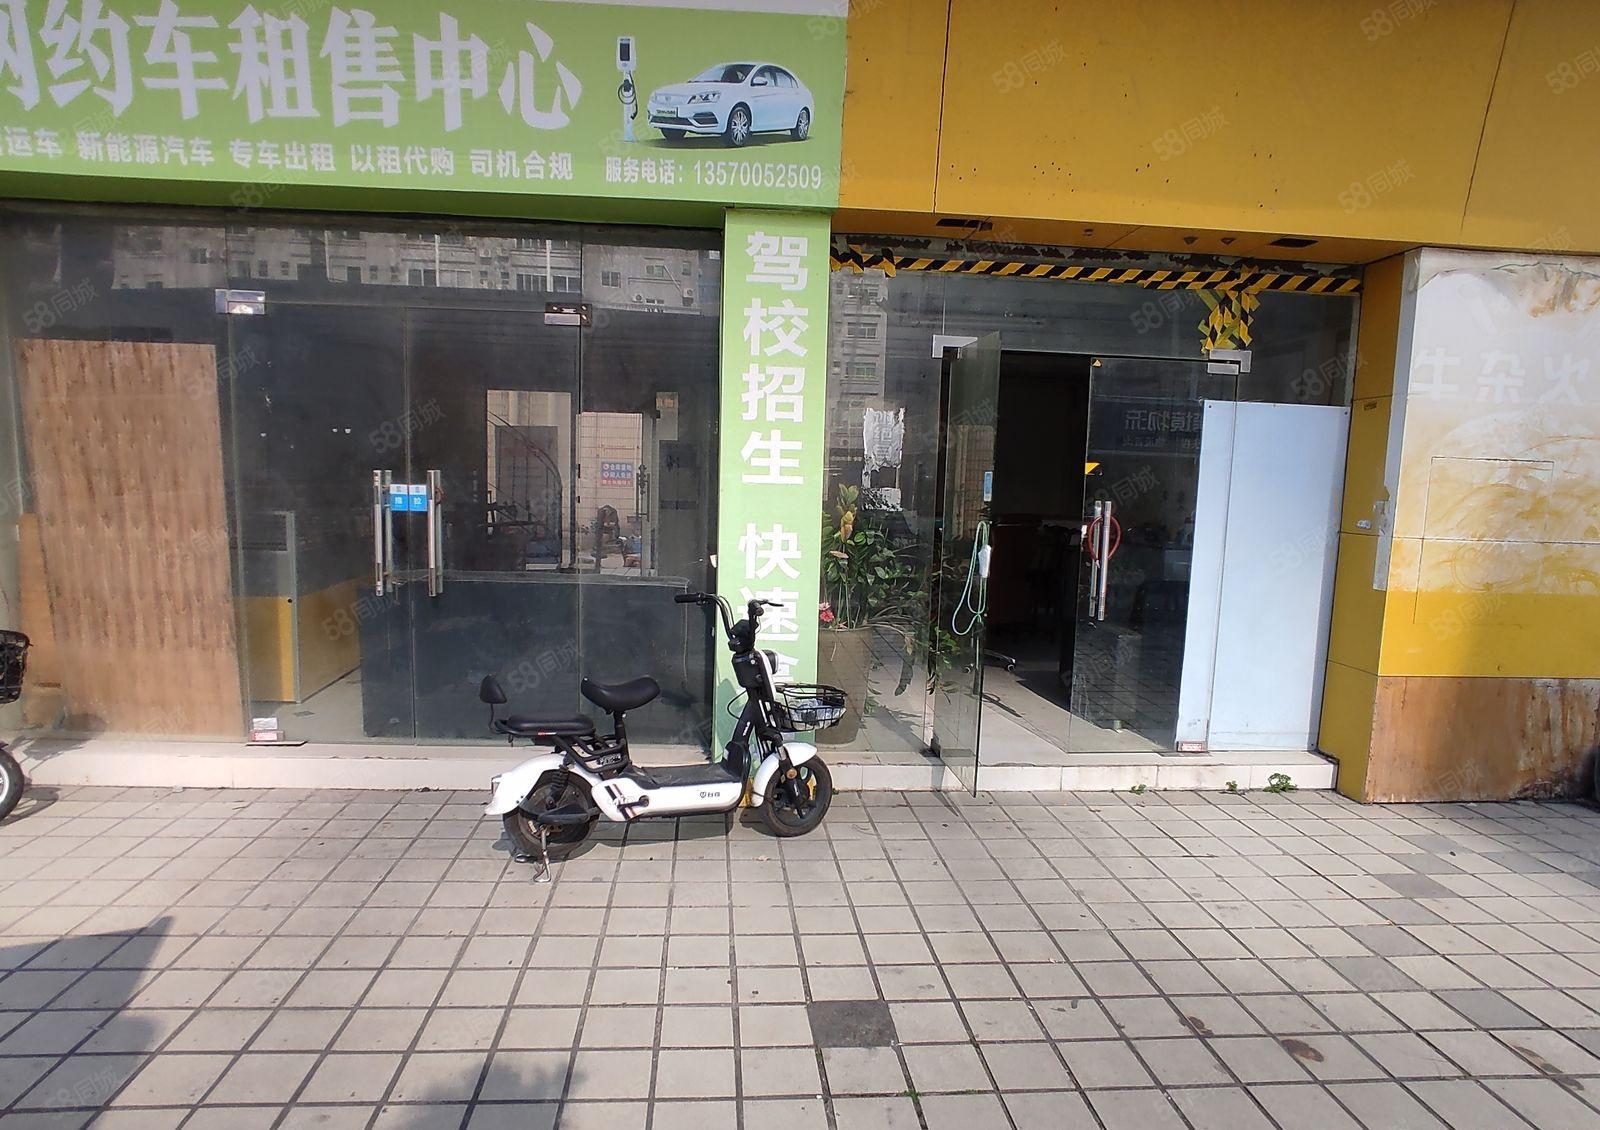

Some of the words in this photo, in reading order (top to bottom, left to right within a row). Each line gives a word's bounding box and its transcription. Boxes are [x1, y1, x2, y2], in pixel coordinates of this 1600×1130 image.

[0, 126, 63, 159] 运车
[76, 129, 215, 168] 新能源汽车
[228, 138, 337, 173] 专车出租
[350, 143, 455, 177] 以租代购
[470, 148, 574, 181] 司机合规
[739, 230, 809, 486] 驾校招生
